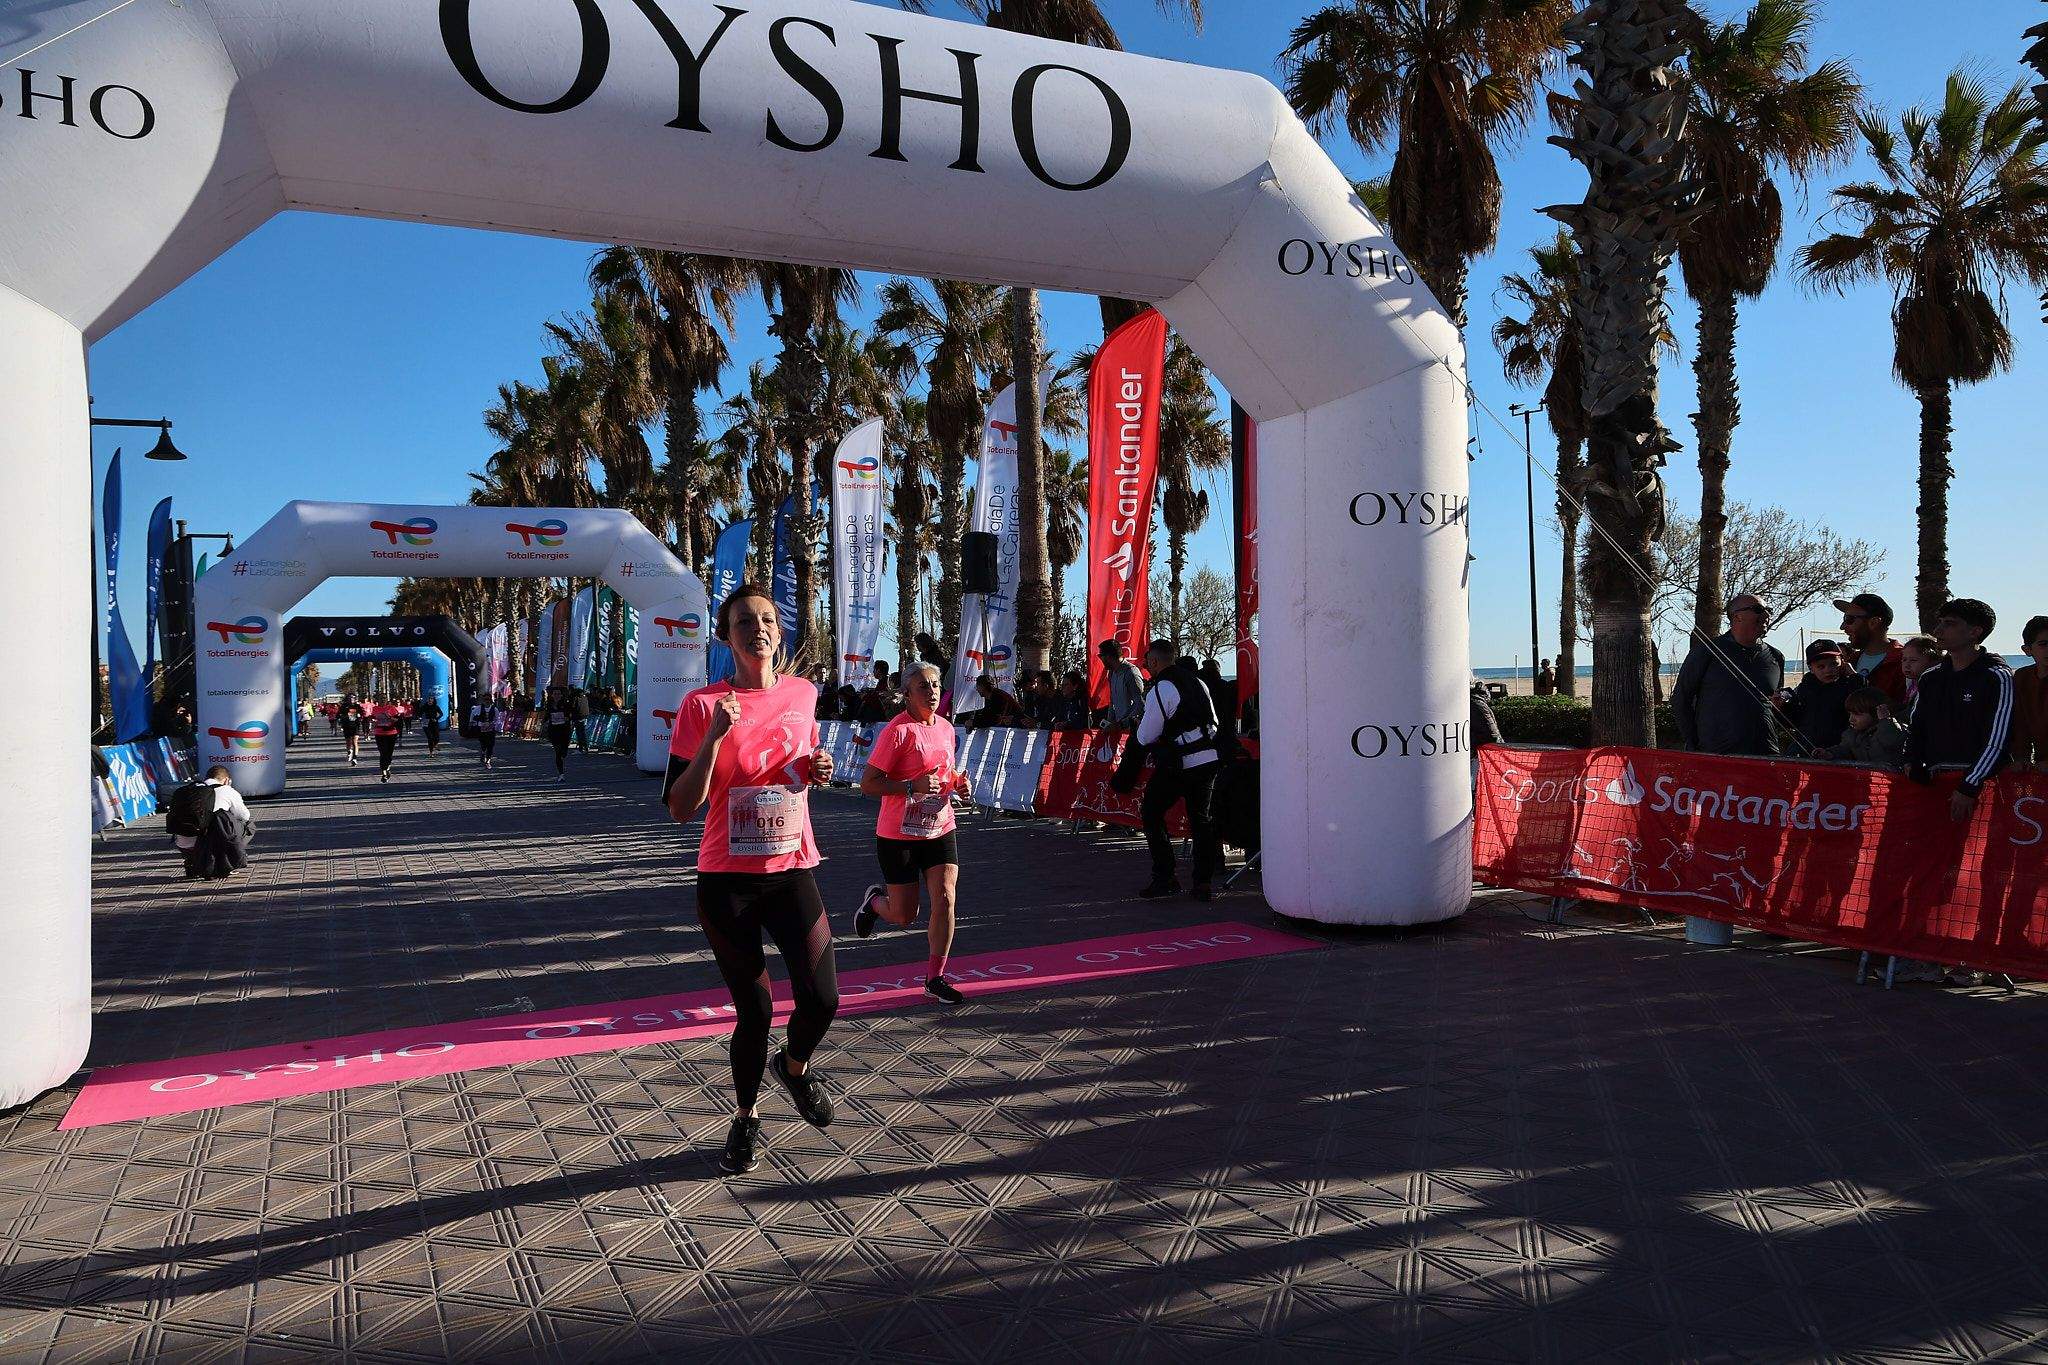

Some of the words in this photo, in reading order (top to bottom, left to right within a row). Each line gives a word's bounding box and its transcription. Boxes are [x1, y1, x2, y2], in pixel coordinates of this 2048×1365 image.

[0, 68, 156, 140] HO
[439, 0, 1131, 191] OYSHO
[1277, 239, 1415, 285] OYSHO
[1112, 368, 1144, 536] Santander
[371, 551, 439, 560] TotalEnergies
[506, 552, 569, 561] TotalEnergies
[861, 513, 876, 598] LasCarreras
[320, 626, 426, 637] VOLVO
[207, 650, 269, 659] TotalEnergies
[653, 641, 701, 650] TotalEnergies
[652, 676, 701, 684] totalenergies.es
[207, 689, 270, 697] totalenergies.es
[208, 754, 270, 764] TotalEnergies
[1500, 769, 1600, 811] Sports
[1650, 775, 1872, 831] Santander
[1076, 933, 1255, 963] OYSHO
[149, 1041, 456, 1093] OYSHO
